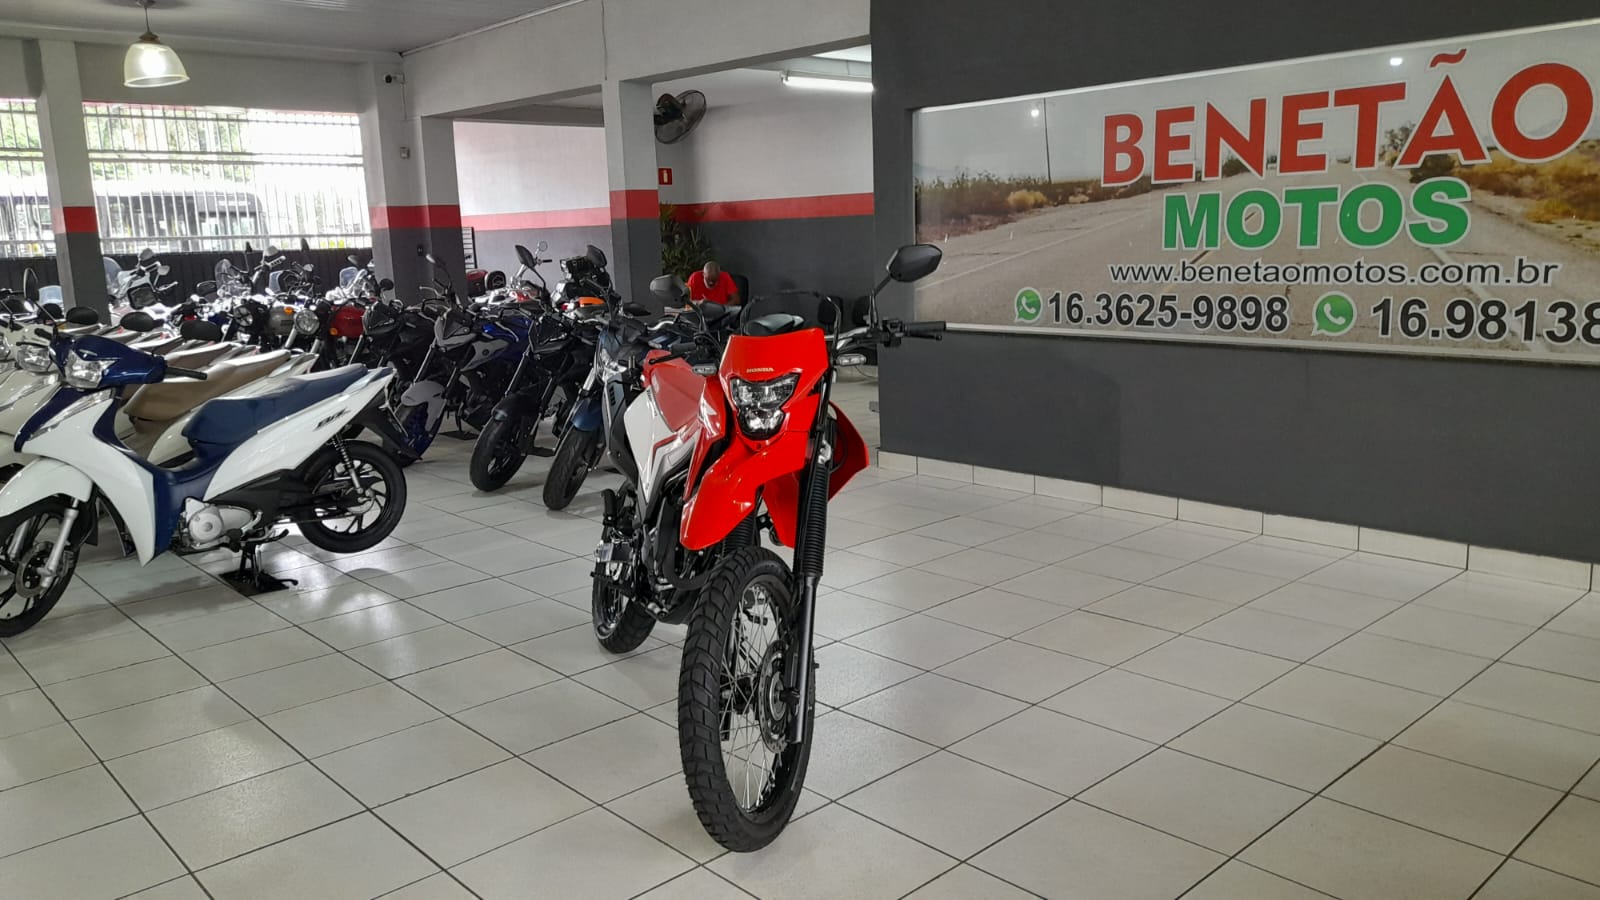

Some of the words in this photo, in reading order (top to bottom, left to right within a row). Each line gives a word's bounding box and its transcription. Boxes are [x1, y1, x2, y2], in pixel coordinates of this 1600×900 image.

[1102, 48, 1594, 185] BENETÃO
[1163, 179, 1471, 250] MOTOS
[1110, 259, 1557, 285] www.benetaomotos.com.br
[1048, 292, 1288, 332] 16.3625-9898
